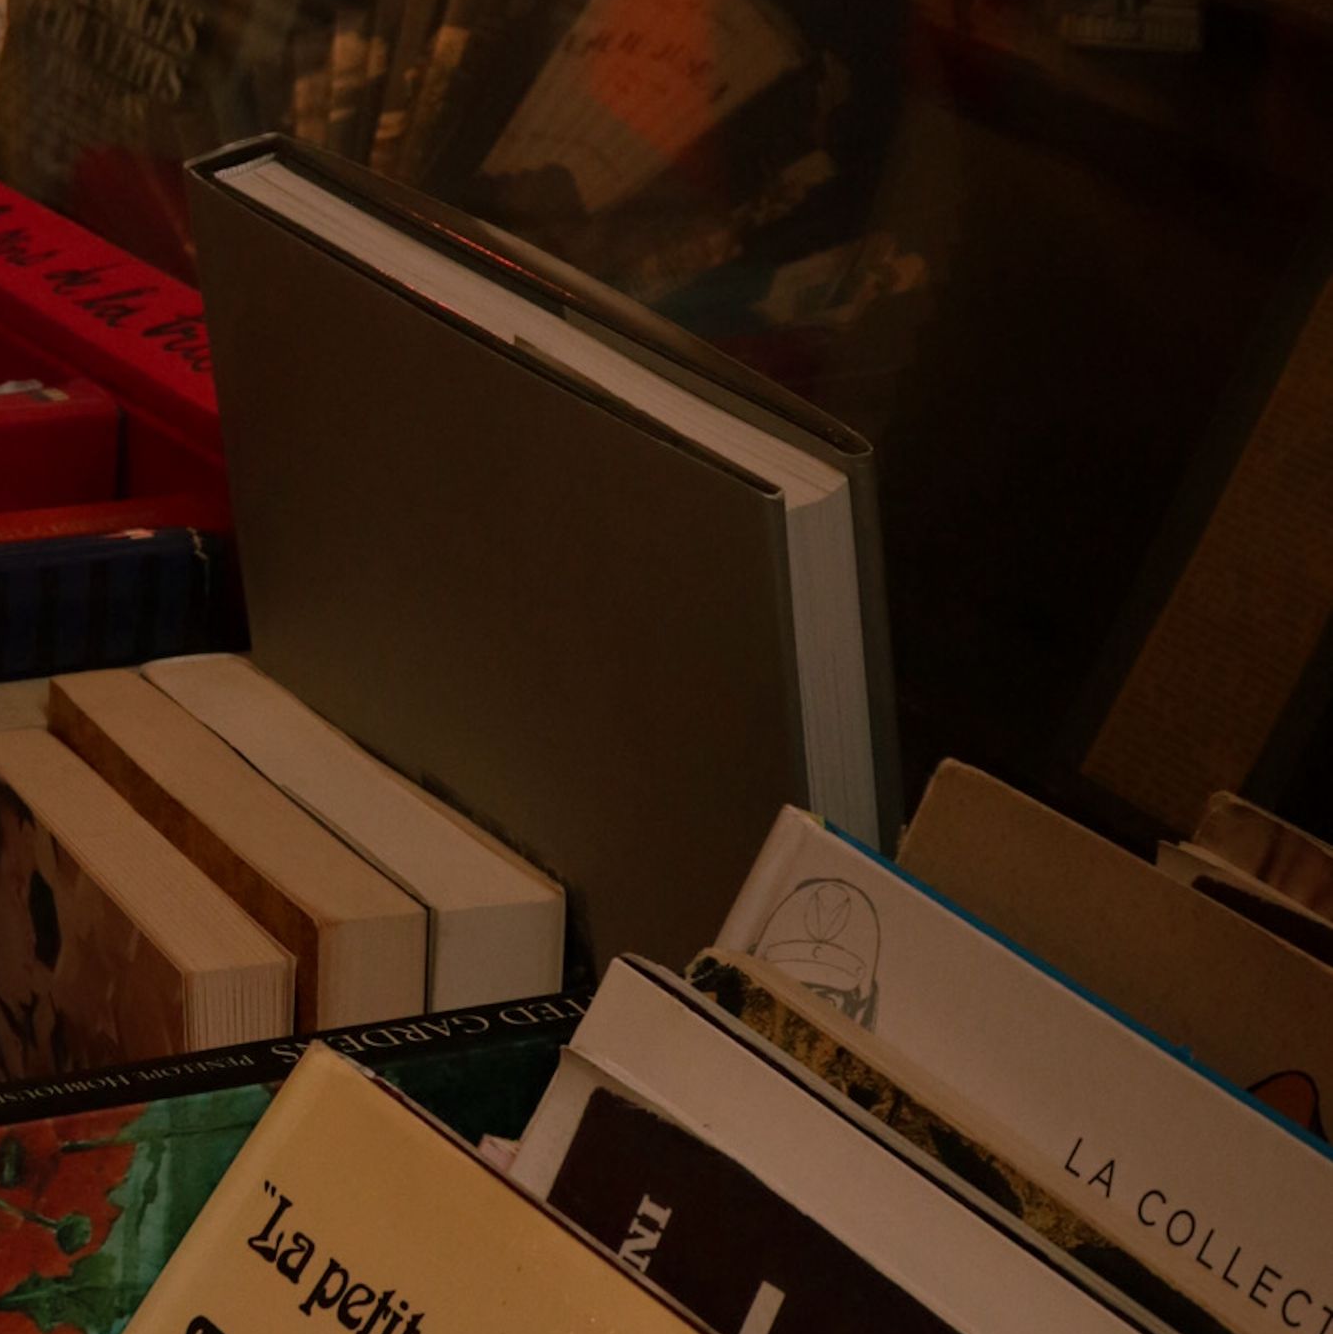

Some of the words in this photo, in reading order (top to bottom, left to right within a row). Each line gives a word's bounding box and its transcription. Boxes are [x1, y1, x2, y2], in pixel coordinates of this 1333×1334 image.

[270, 1002, 493, 1067] GARDES
[137, 1050, 257, 1090] PENELOPE
[1064, 1137, 1115, 1198] LA
